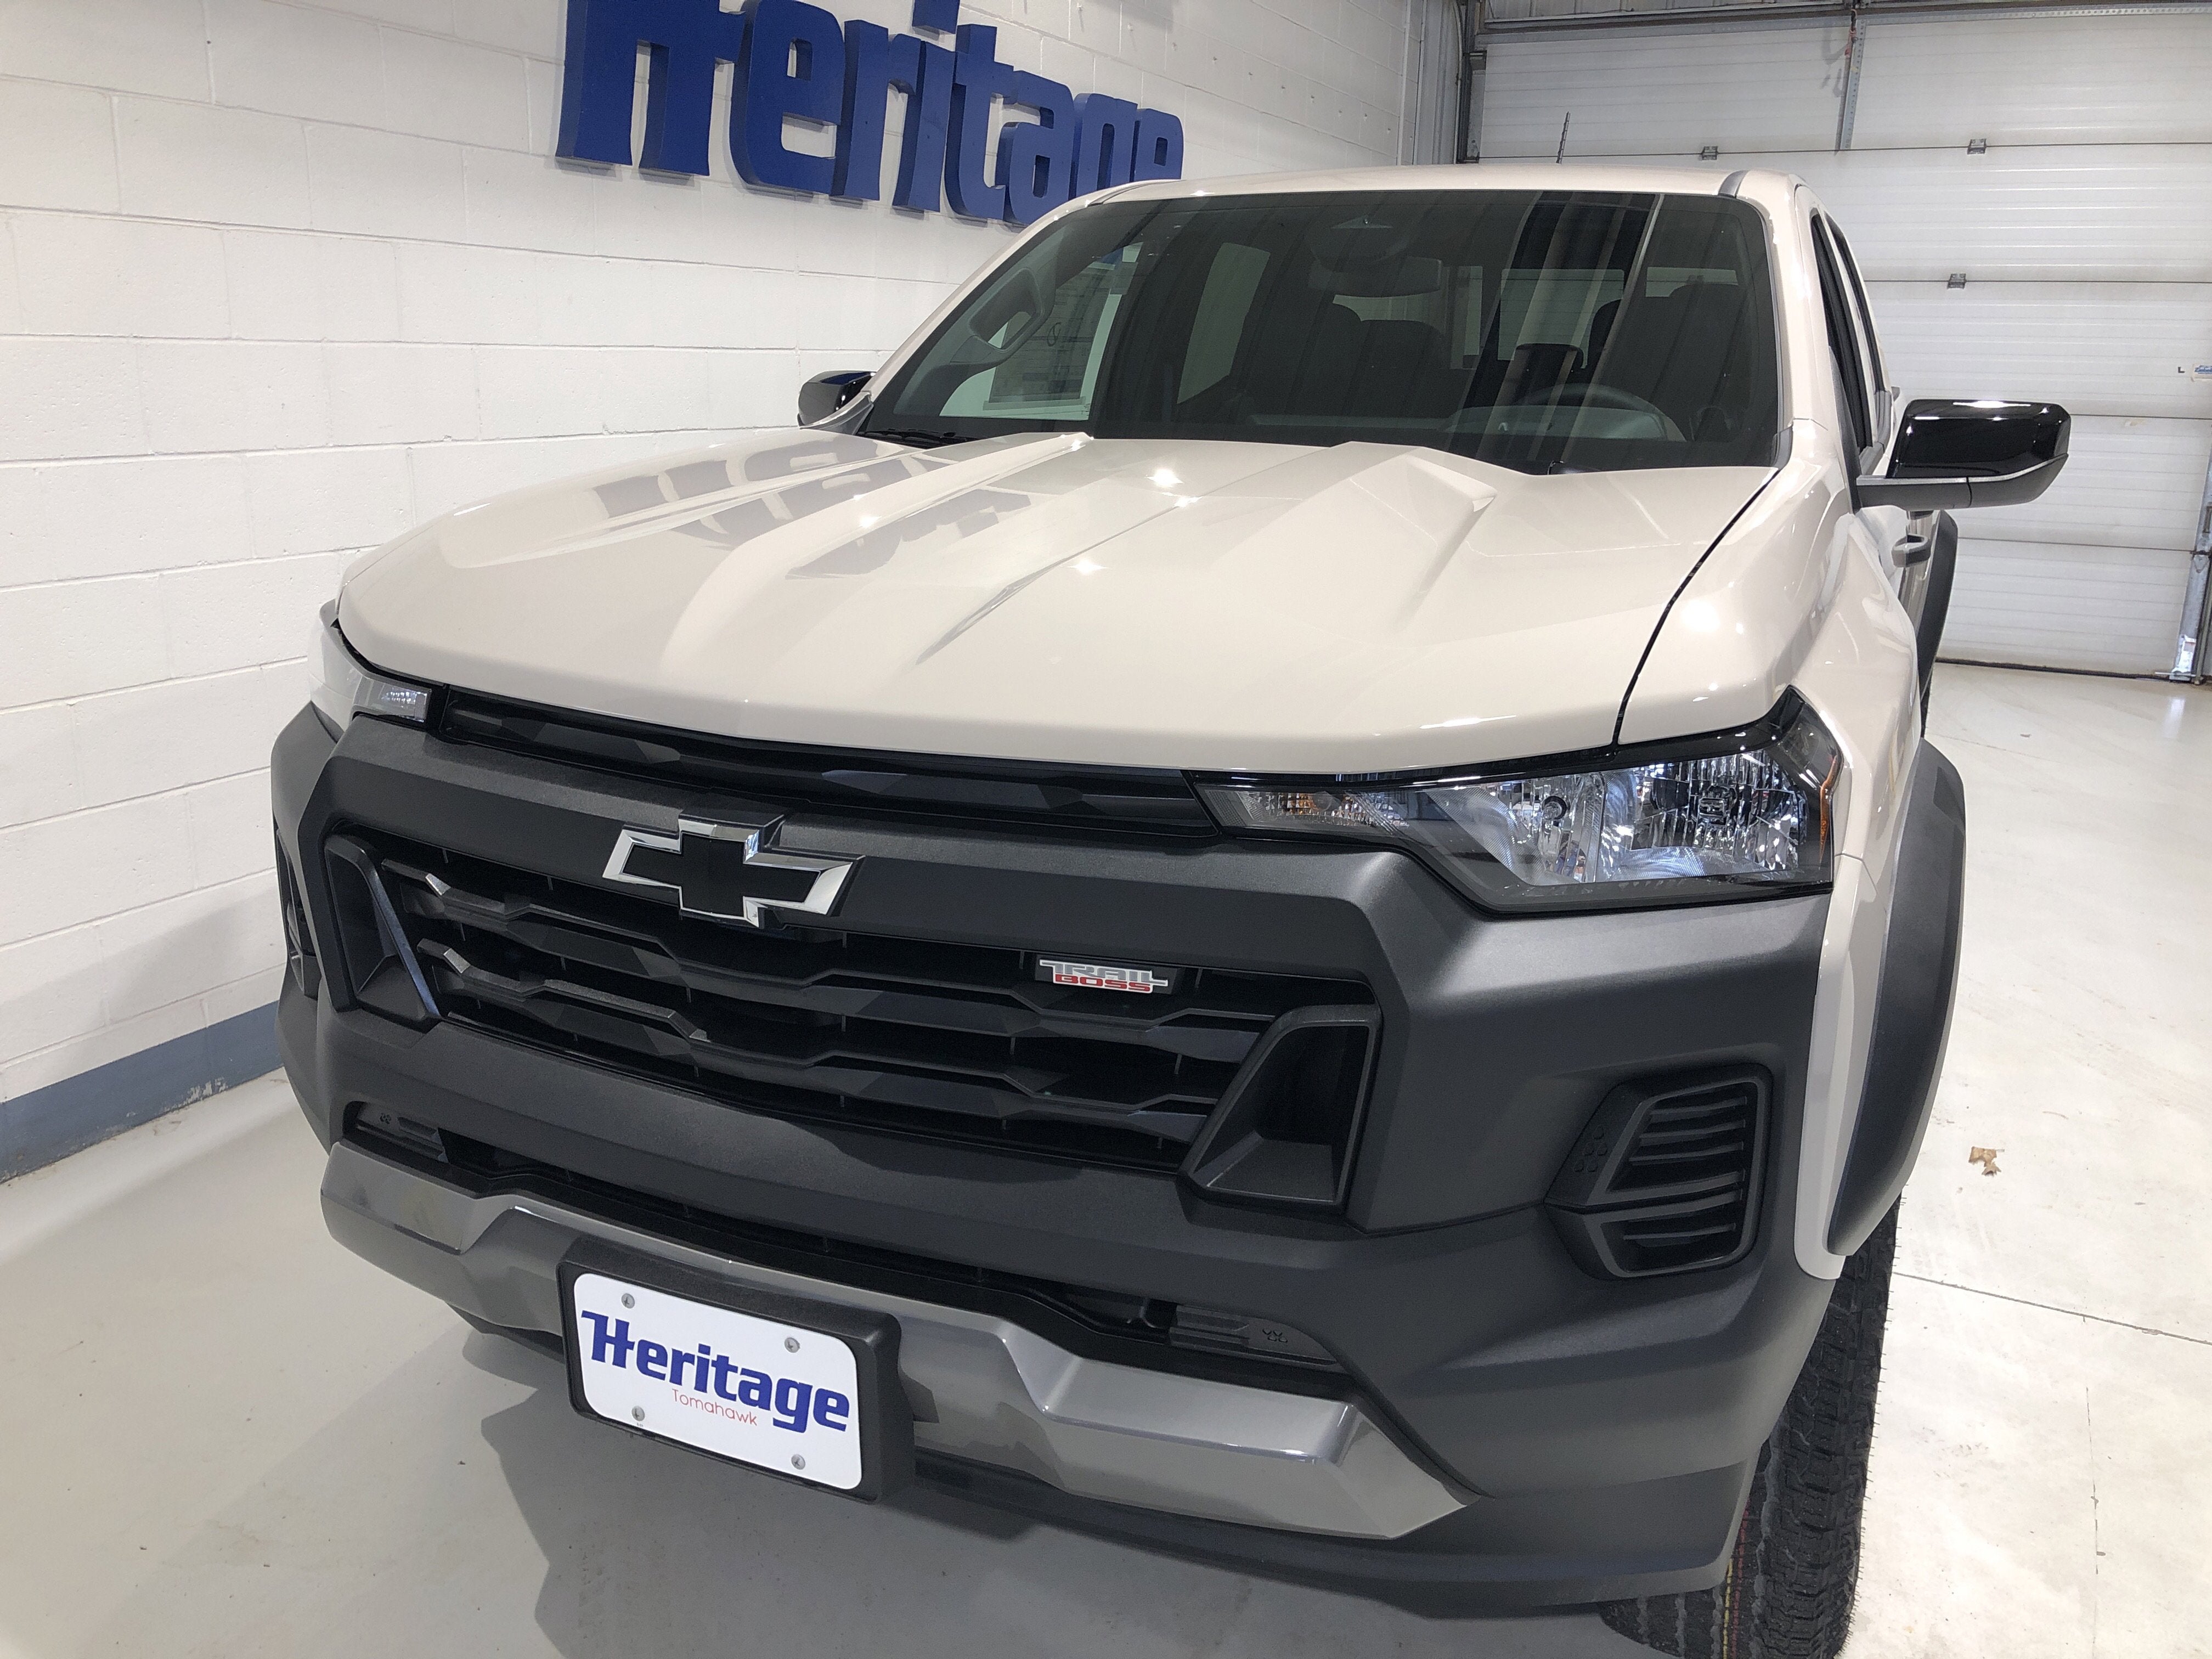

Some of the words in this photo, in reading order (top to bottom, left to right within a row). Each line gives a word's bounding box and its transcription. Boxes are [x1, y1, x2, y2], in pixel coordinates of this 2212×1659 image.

[1040, 960, 1168, 986] TRAIL
[1054, 974, 1152, 992] BOSS
[581, 1310, 850, 1433] Heritage
[672, 1389, 758, 1426] Tomahawk
